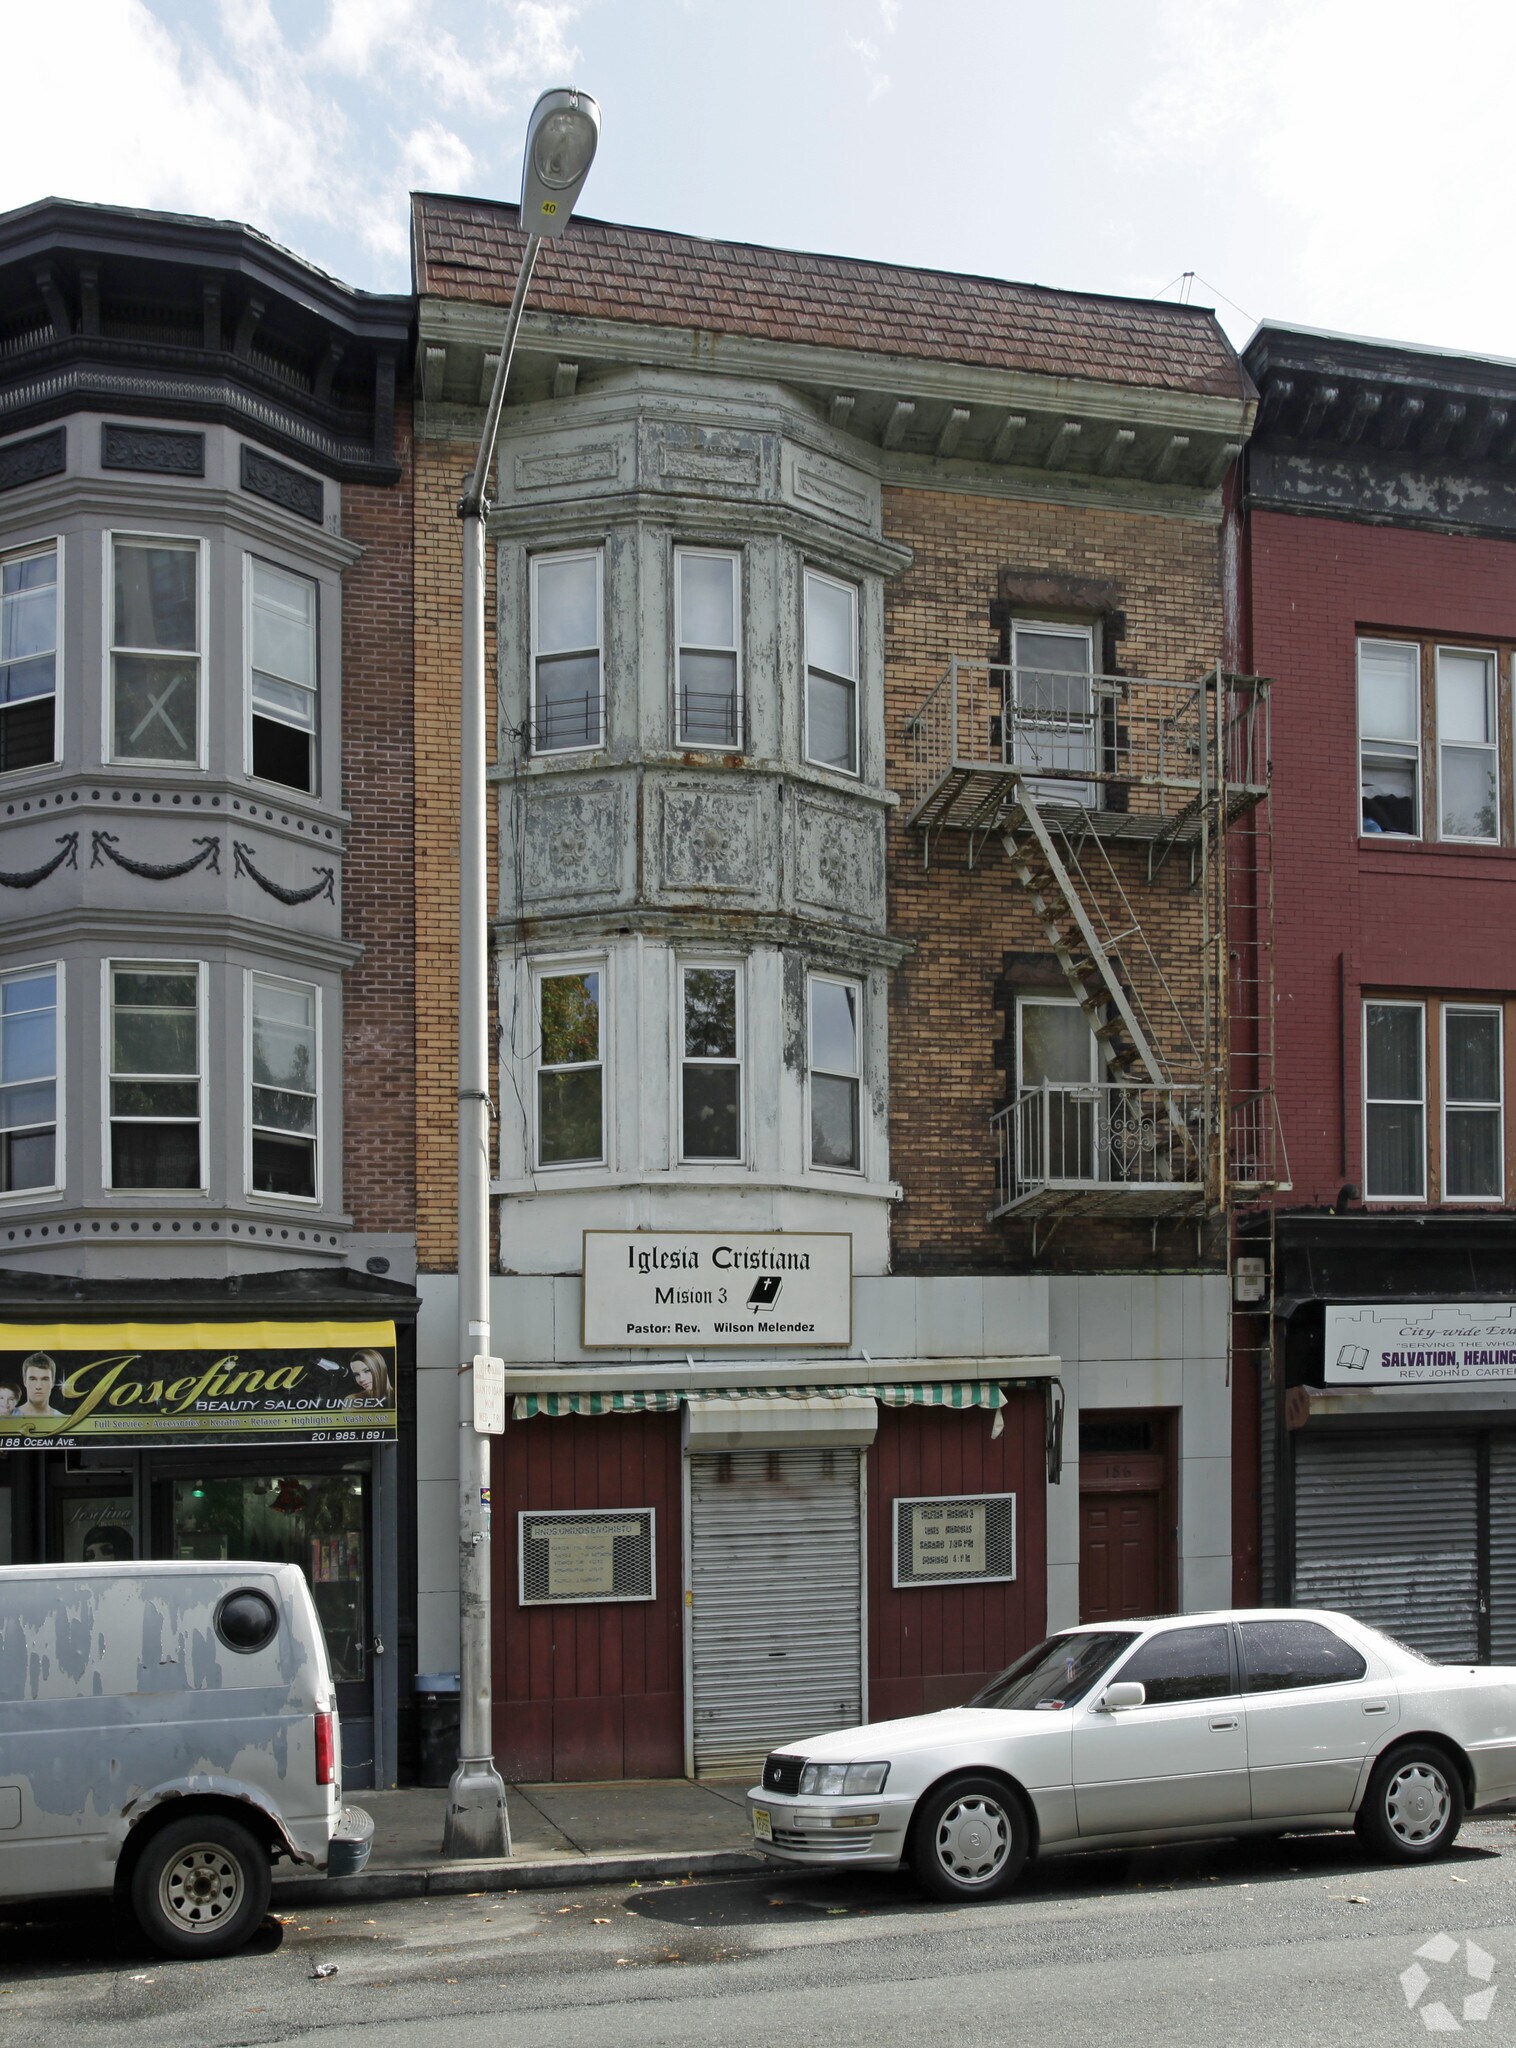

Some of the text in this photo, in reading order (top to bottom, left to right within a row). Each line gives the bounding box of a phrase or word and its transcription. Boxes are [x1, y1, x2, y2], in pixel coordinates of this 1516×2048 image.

[543, 203, 556, 213] 40
[628, 1245, 811, 1274] Iglesia Cristiana
[654, 1286, 728, 1304] Mision 3
[626, 1322, 815, 1333] Pastor: Rev. Wilson Melendez
[1399, 1326, 1481, 1340] City-wide
[1381, 1350, 1516, 1369] SALVATION, HEALING
[1400, 1370, 1425, 1378] REV.
[20, 1353, 309, 1438] Josefina
[196, 1397, 387, 1411] BEAUTY SALON UNISEX
[94, 1420, 110, 1428] Full
[112, 1420, 144, 1428] Service
[152, 1418, 200, 1428] Accessories
[210, 1418, 240, 1427] Keratin
[250, 1417, 281, 1426] Relaxer
[291, 1416, 333, 1426] Highlights
[343, 1415, 364, 1424] Wash
[375, 1414, 388, 1423] Set
[24, 1438, 54, 1446] OCEAN
[311, 1431, 386, 1441] 201.985.1891
